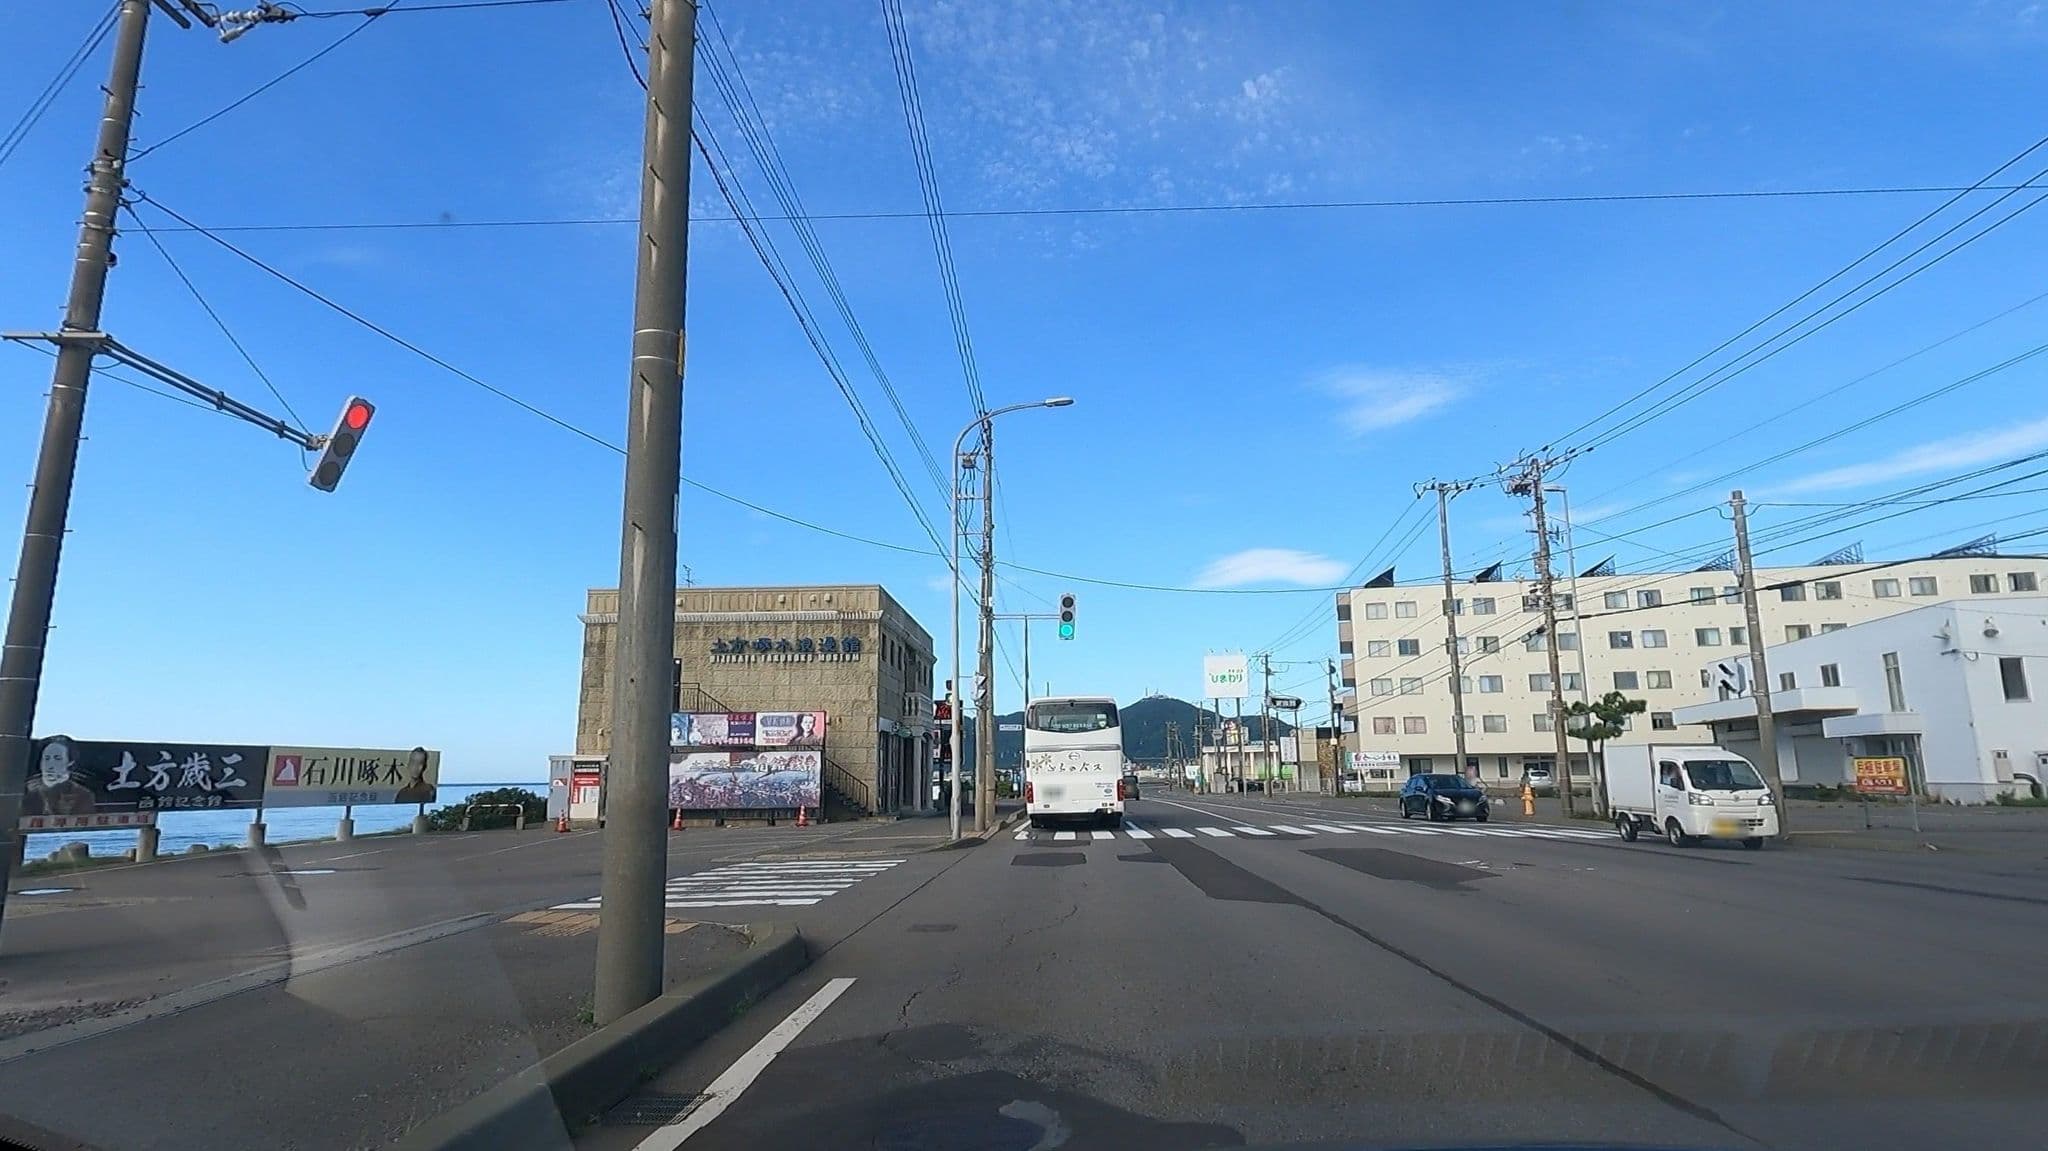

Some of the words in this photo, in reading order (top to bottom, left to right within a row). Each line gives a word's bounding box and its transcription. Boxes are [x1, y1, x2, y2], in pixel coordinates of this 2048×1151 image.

[106, 750, 248, 792] 土方歳三
[302, 756, 404, 786] 石川啄木
